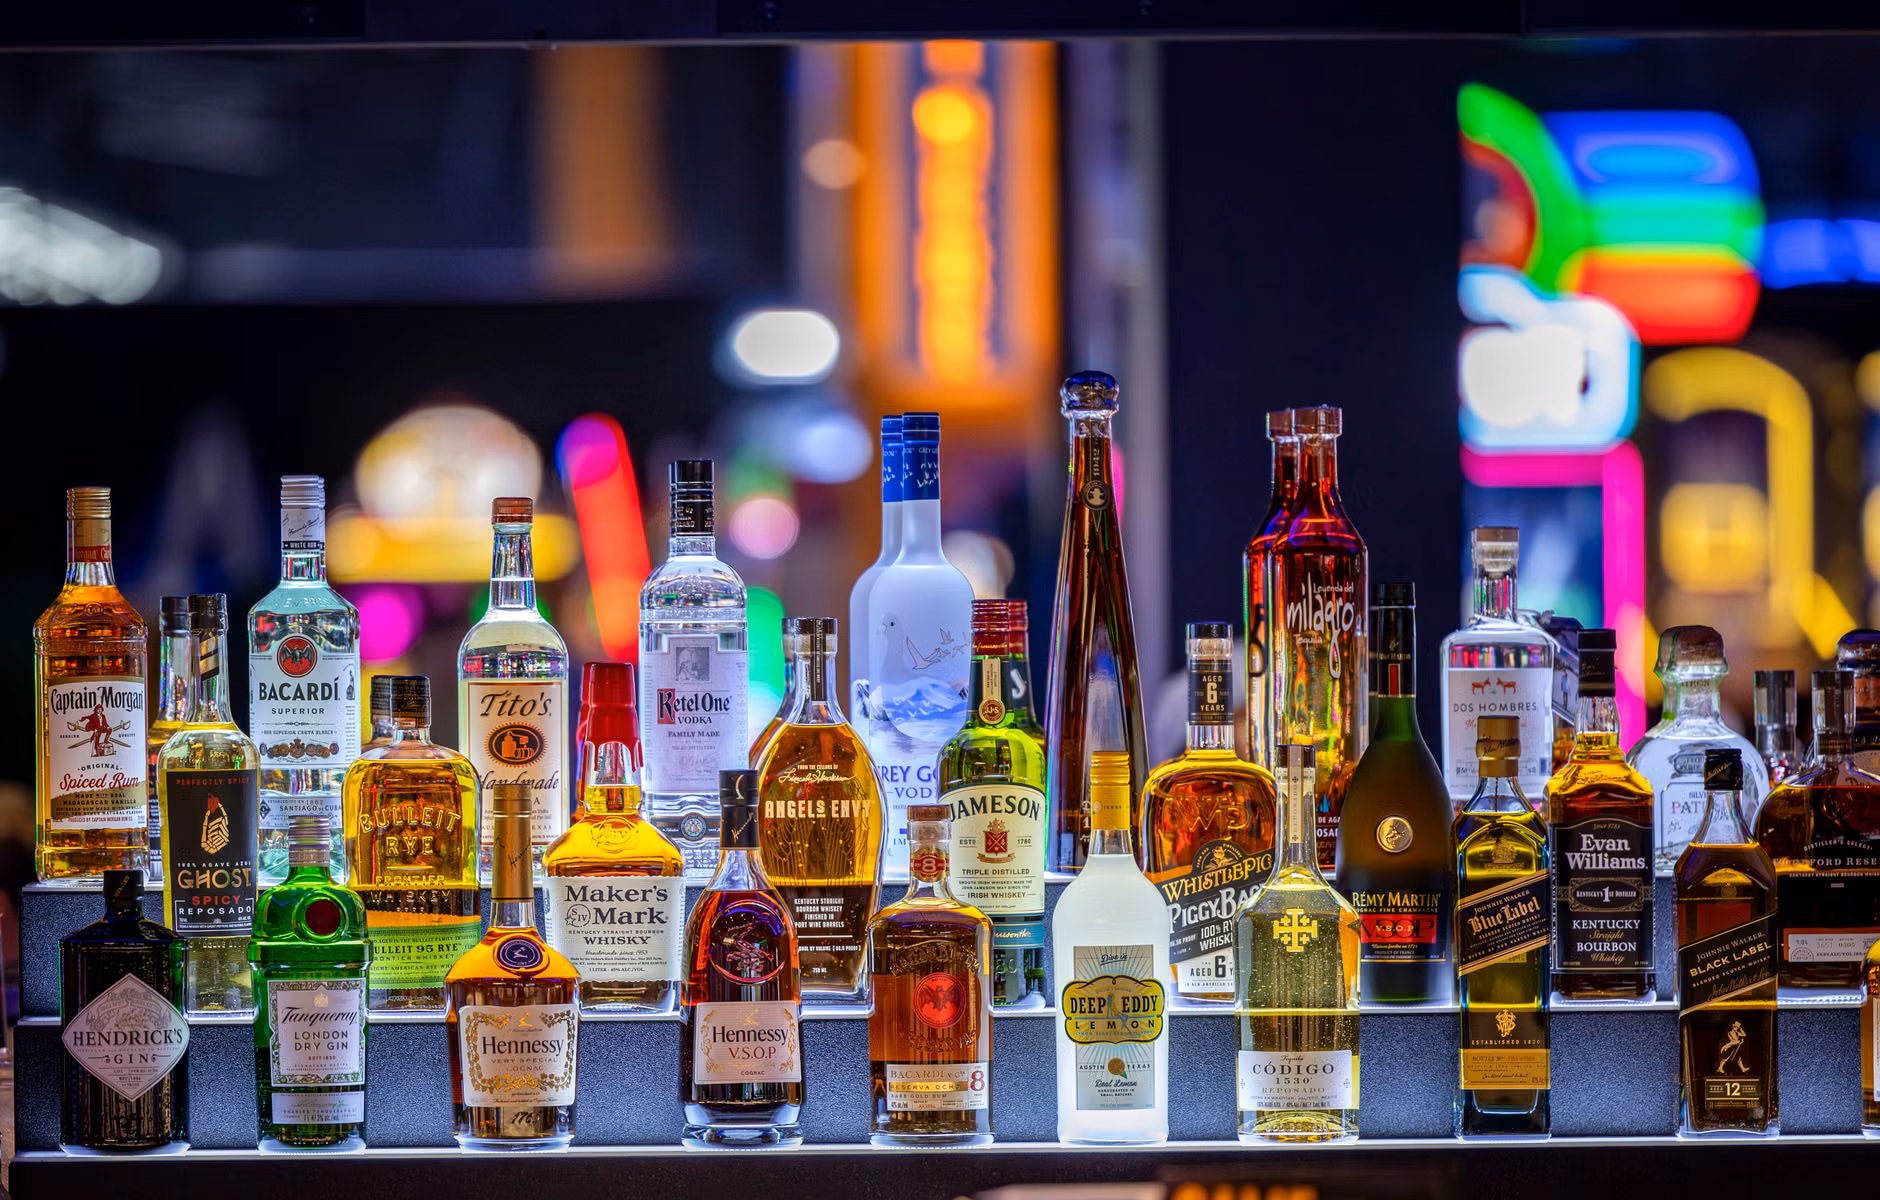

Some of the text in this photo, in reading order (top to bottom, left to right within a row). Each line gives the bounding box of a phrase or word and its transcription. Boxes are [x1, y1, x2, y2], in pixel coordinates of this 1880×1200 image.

[1313, 581, 1354, 593] Leyenda del
[1286, 572, 1355, 680] milagro
[260, 677, 340, 701] BACARDÍ
[1207, 682, 1217, 704] 6
[51, 686, 144, 714] Captain Morgan
[480, 690, 552, 717] Tito's
[658, 690, 730, 722] Ketel One
[1200, 704, 1225, 712] YEARS
[1454, 702, 1536, 712] DOS HOMBRES
[677, 716, 712, 724] VODKA
[81, 763, 120, 771] ORIGINAL
[878, 766, 910, 782] REY
[60, 772, 139, 791] Spiced Rum
[831, 800, 871, 818] ENVY
[950, 795, 1040, 822] JAMESON
[359, 806, 461, 833] BULLEIT
[386, 836, 434, 856] RYE
[1580, 833, 1630, 851] Evan
[1803, 839, 1844, 852] DISTILLER'S
[922, 859, 937, 872] 8
[178, 868, 252, 889] GHOST
[376, 876, 445, 886] FRONTIER
[1162, 853, 1273, 903] WHISTLEPIG
[192, 896, 241, 906] SPICY
[564, 885, 668, 902] Maker's
[1352, 891, 1439, 907] RÉMY MARTIN
[1474, 889, 1530, 915] JOHNNIE WALKER
[179, 906, 251, 915] REPOSADO
[592, 906, 666, 925] Mark
[1167, 882, 1265, 934] PIGGYBAC
[1467, 896, 1540, 936] Blue Label
[1201, 924, 1221, 939] 100%
[1572, 919, 1641, 930] KENTUCKY
[584, 936, 651, 945] WHISKY
[1200, 933, 1233, 951] WHISK
[1589, 929, 1624, 941] Straight
[374, 943, 458, 954] ULLEIT 95 RYE
[1576, 942, 1637, 952] BOURBON
[1696, 932, 1763, 963] JOHNNIE WALKER
[1190, 955, 1226, 978] AGED 6
[1590, 952, 1625, 965] Whiskey
[1689, 941, 1772, 977] BLACK LABEL
[1692, 955, 1770, 987] BLENDED SCOTCH WHISKY
[1070, 995, 1158, 1014] DEEP EDDY
[281, 1006, 358, 1027] Tanqueray
[1075, 1019, 1155, 1030] LEMON
[73, 1028, 183, 1047] HENDRICK'S
[295, 1030, 348, 1040] LONDON
[712, 1025, 788, 1046] Hennessy
[294, 1040, 349, 1051] DRY GIN
[482, 1036, 564, 1056] Hennessy
[728, 1046, 776, 1060] V.S.O.P
[114, 1054, 148, 1064] GIN
[1280, 1055, 1304, 1064] Tequila
[1252, 1062, 1335, 1075] CÓDIGO
[970, 1070, 985, 1091] 8
[1095, 1079, 1137, 1088] Real Lemon
[1275, 1077, 1310, 1085] 1530
[1724, 1082, 1741, 1097] 12
